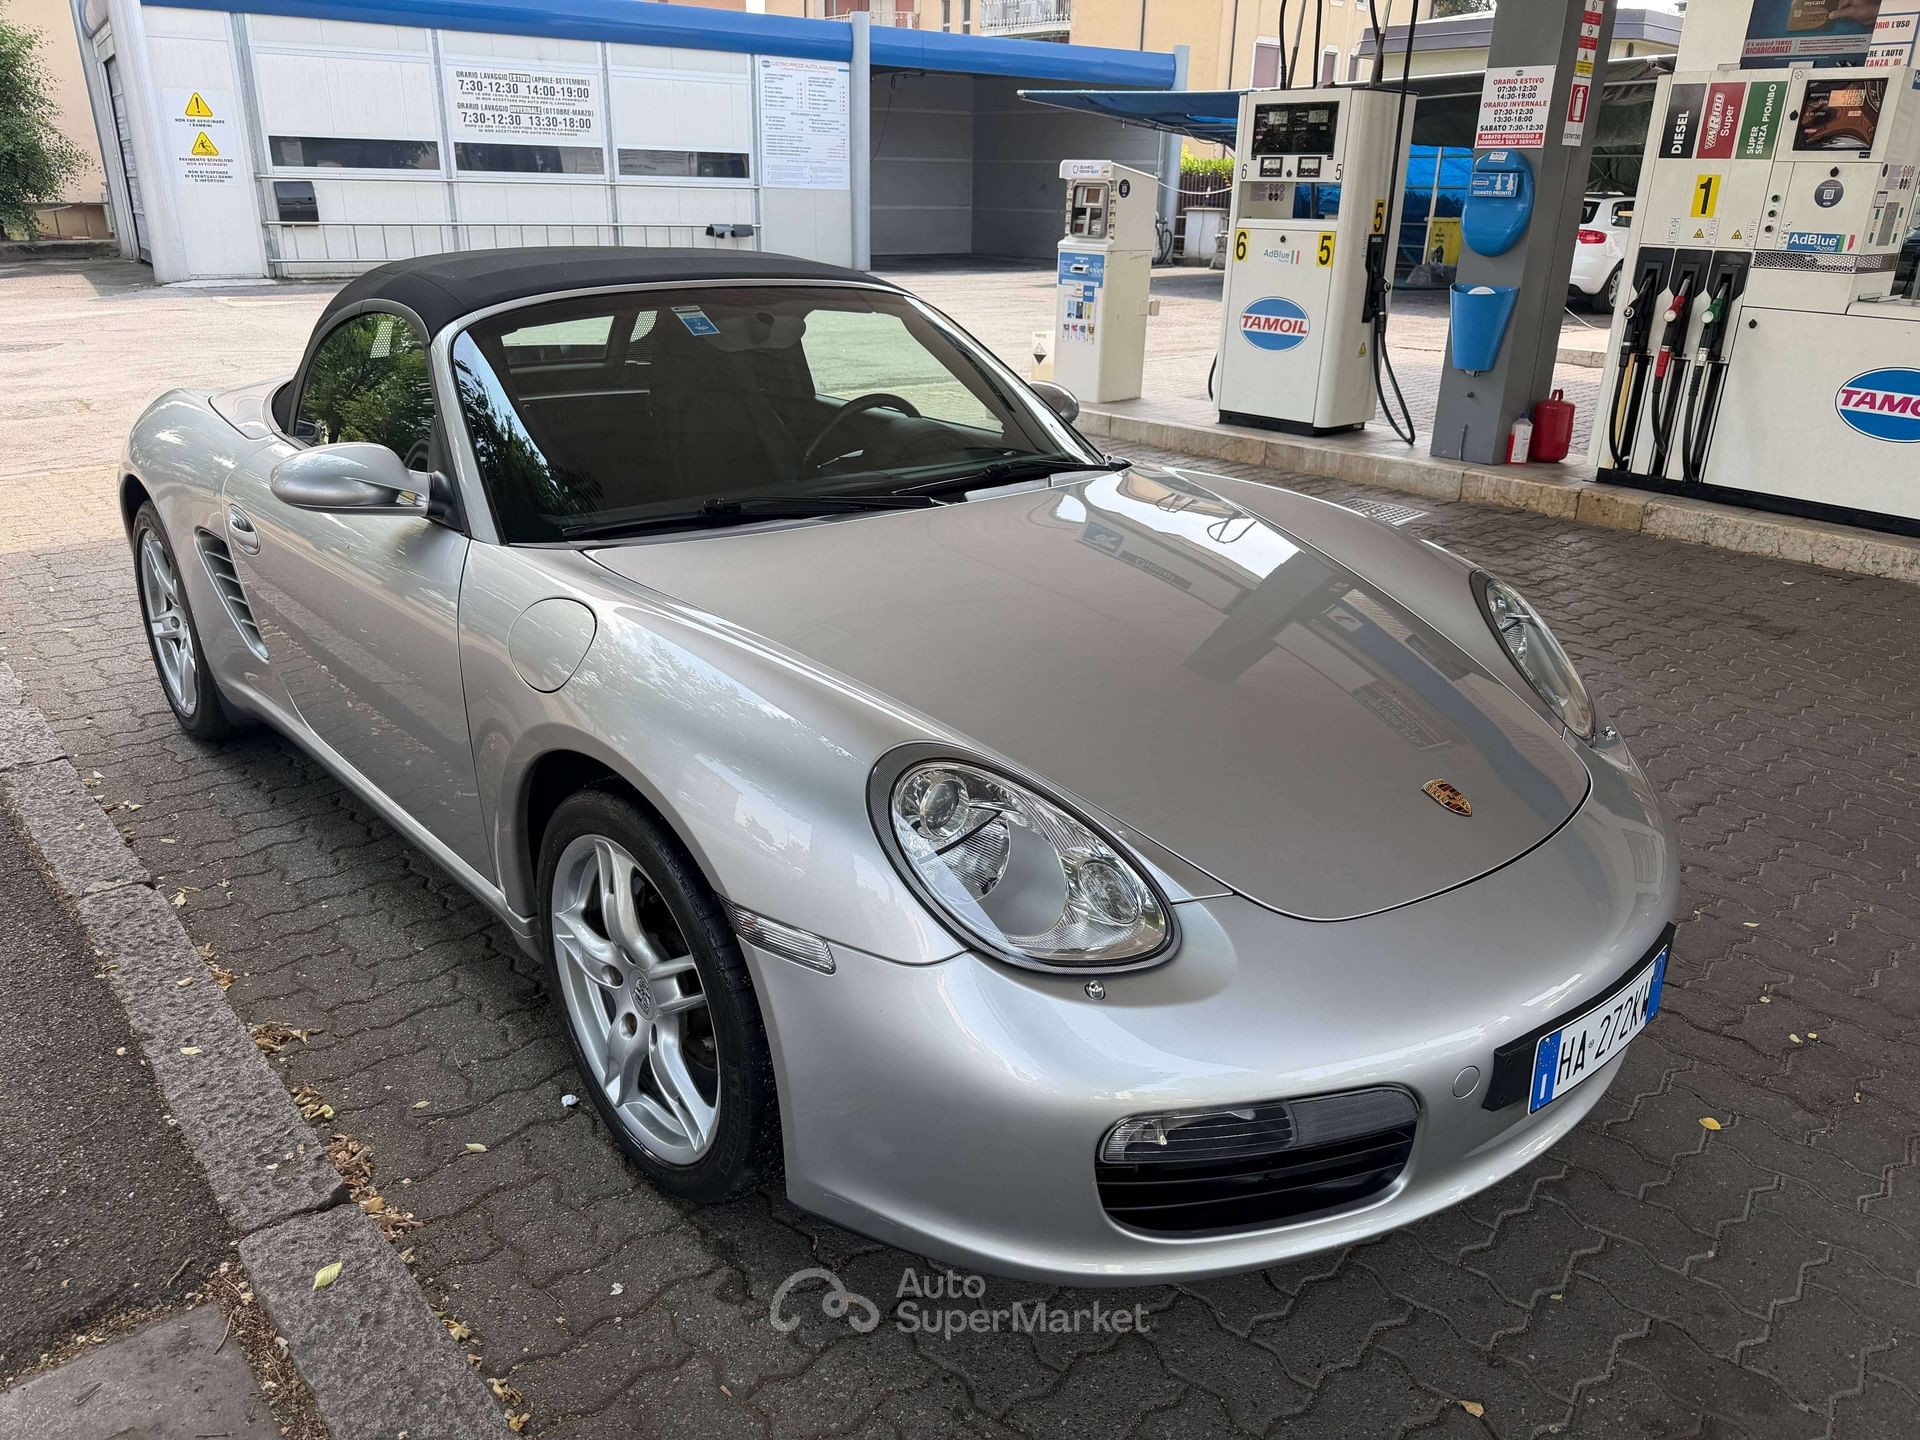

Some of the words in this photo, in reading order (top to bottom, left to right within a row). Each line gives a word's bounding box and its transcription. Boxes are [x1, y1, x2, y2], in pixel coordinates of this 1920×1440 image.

[458, 80, 518, 94] 7:30-12:30
[526, 85, 589, 98] 14:00-19:00
[480, 72, 507, 80] LAVAGGIO
[532, 75, 590, 86] (APRILE-SETTEMBRE)
[457, 102, 479, 111] ORARIO
[481, 103, 508, 112] LAVAGGIO
[543, 107, 593, 117] (OTTOBRE-MARZO)
[462, 112, 521, 126] 7:30-12:30
[529, 116, 591, 129] 13:30-18:00
[1720, 105, 1734, 136] Super
[1755, 124, 1768, 154] SENZA
[1762, 84, 1777, 122] PIOMBO
[1671, 110, 1689, 154] DIESEL
[1747, 126, 1759, 154] SUPER
[1241, 163, 1248, 180] 6
[1335, 163, 1342, 180] 5
[1700, 177, 1712, 214] 1
[1374, 203, 1384, 232] 5
[1236, 231, 1247, 260] 6
[1319, 235, 1332, 265] 5
[1789, 234, 1837, 246] AdBlue
[1263, 249, 1290, 259] AdBlue
[1242, 315, 1307, 334] TAMOIL
[1557, 1028, 1587, 1086] HA
